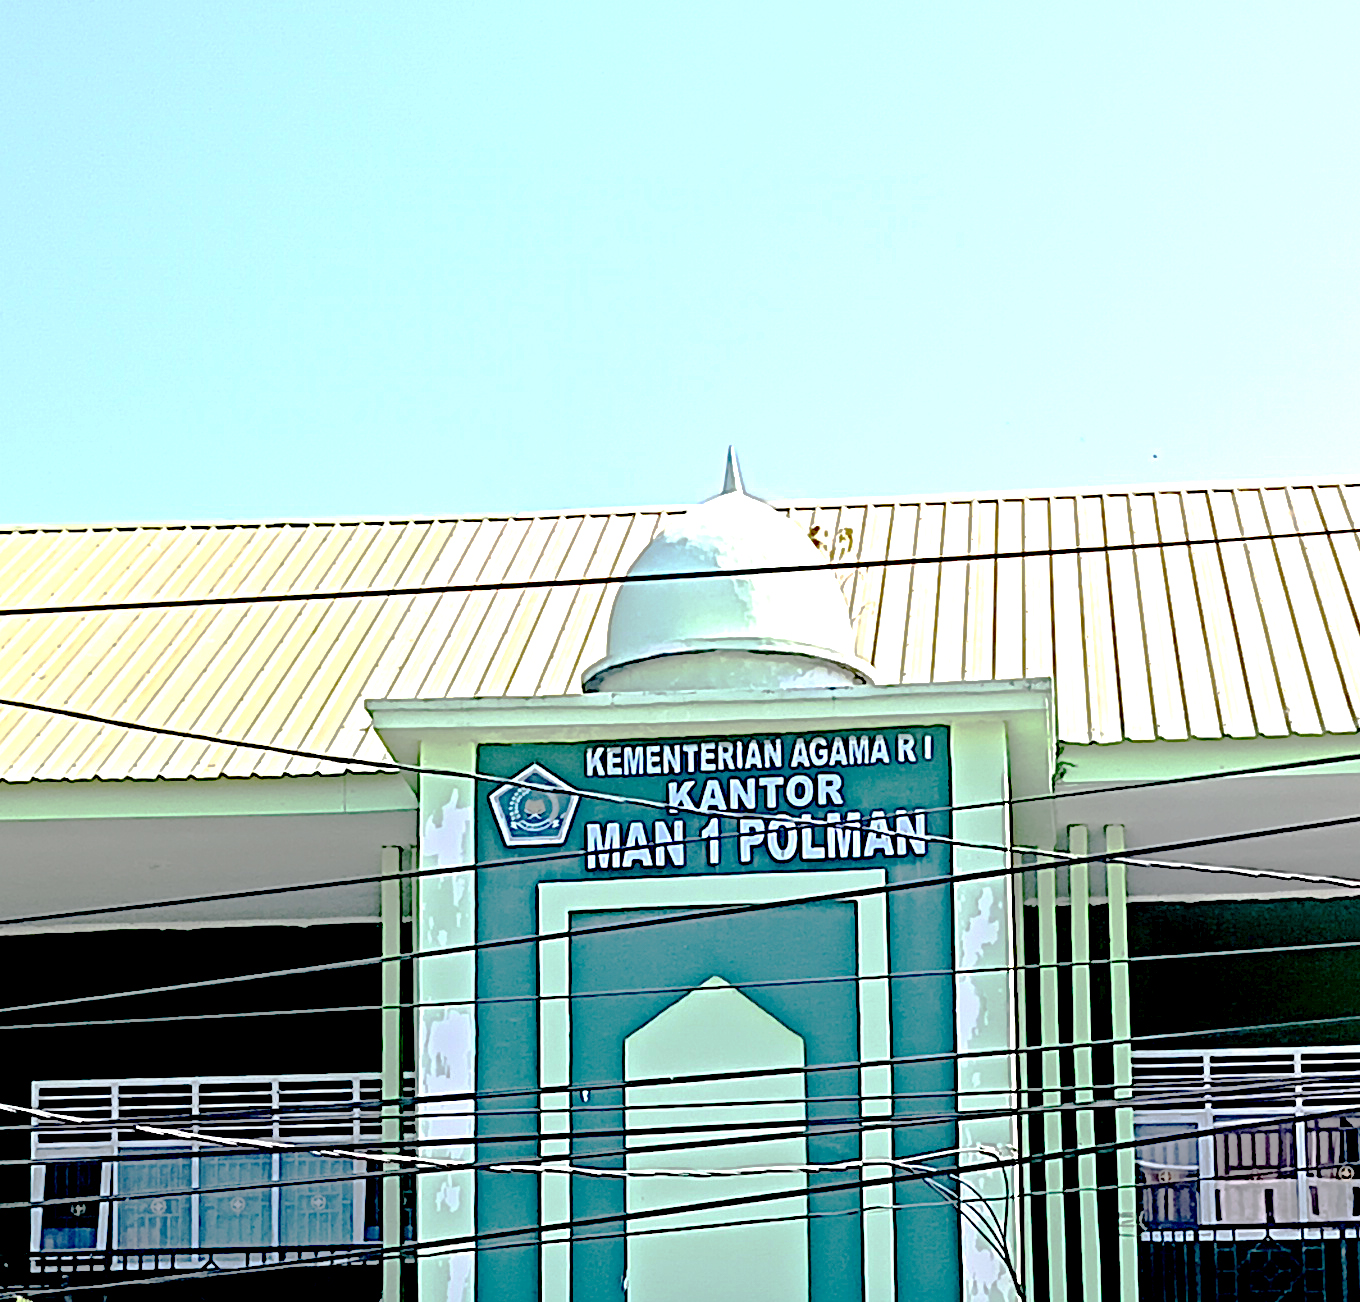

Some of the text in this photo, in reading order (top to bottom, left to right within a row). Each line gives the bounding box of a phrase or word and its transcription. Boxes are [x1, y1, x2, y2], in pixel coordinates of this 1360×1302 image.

[585, 733, 933, 777] KEMENTERIAN AGAMA R I
[668, 773, 844, 813] KANTOR
[585, 809, 926, 870] MAN 1 POLMAN
